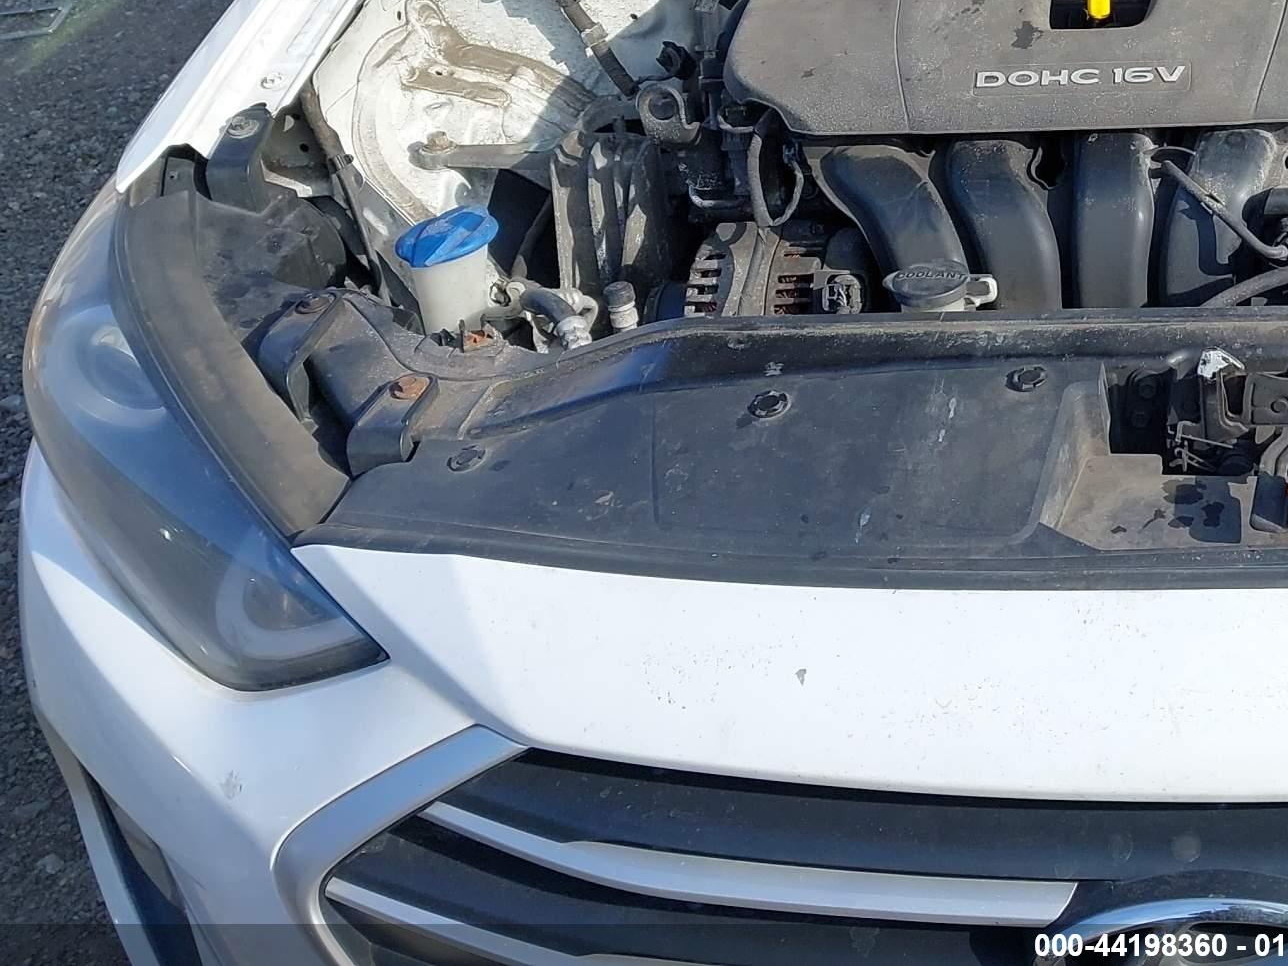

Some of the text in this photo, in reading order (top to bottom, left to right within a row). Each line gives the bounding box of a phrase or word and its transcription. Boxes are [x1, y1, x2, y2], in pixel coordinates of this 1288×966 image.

[975, 65, 1186, 88] DOHC 16V
[895, 270, 968, 280] COOLANT
